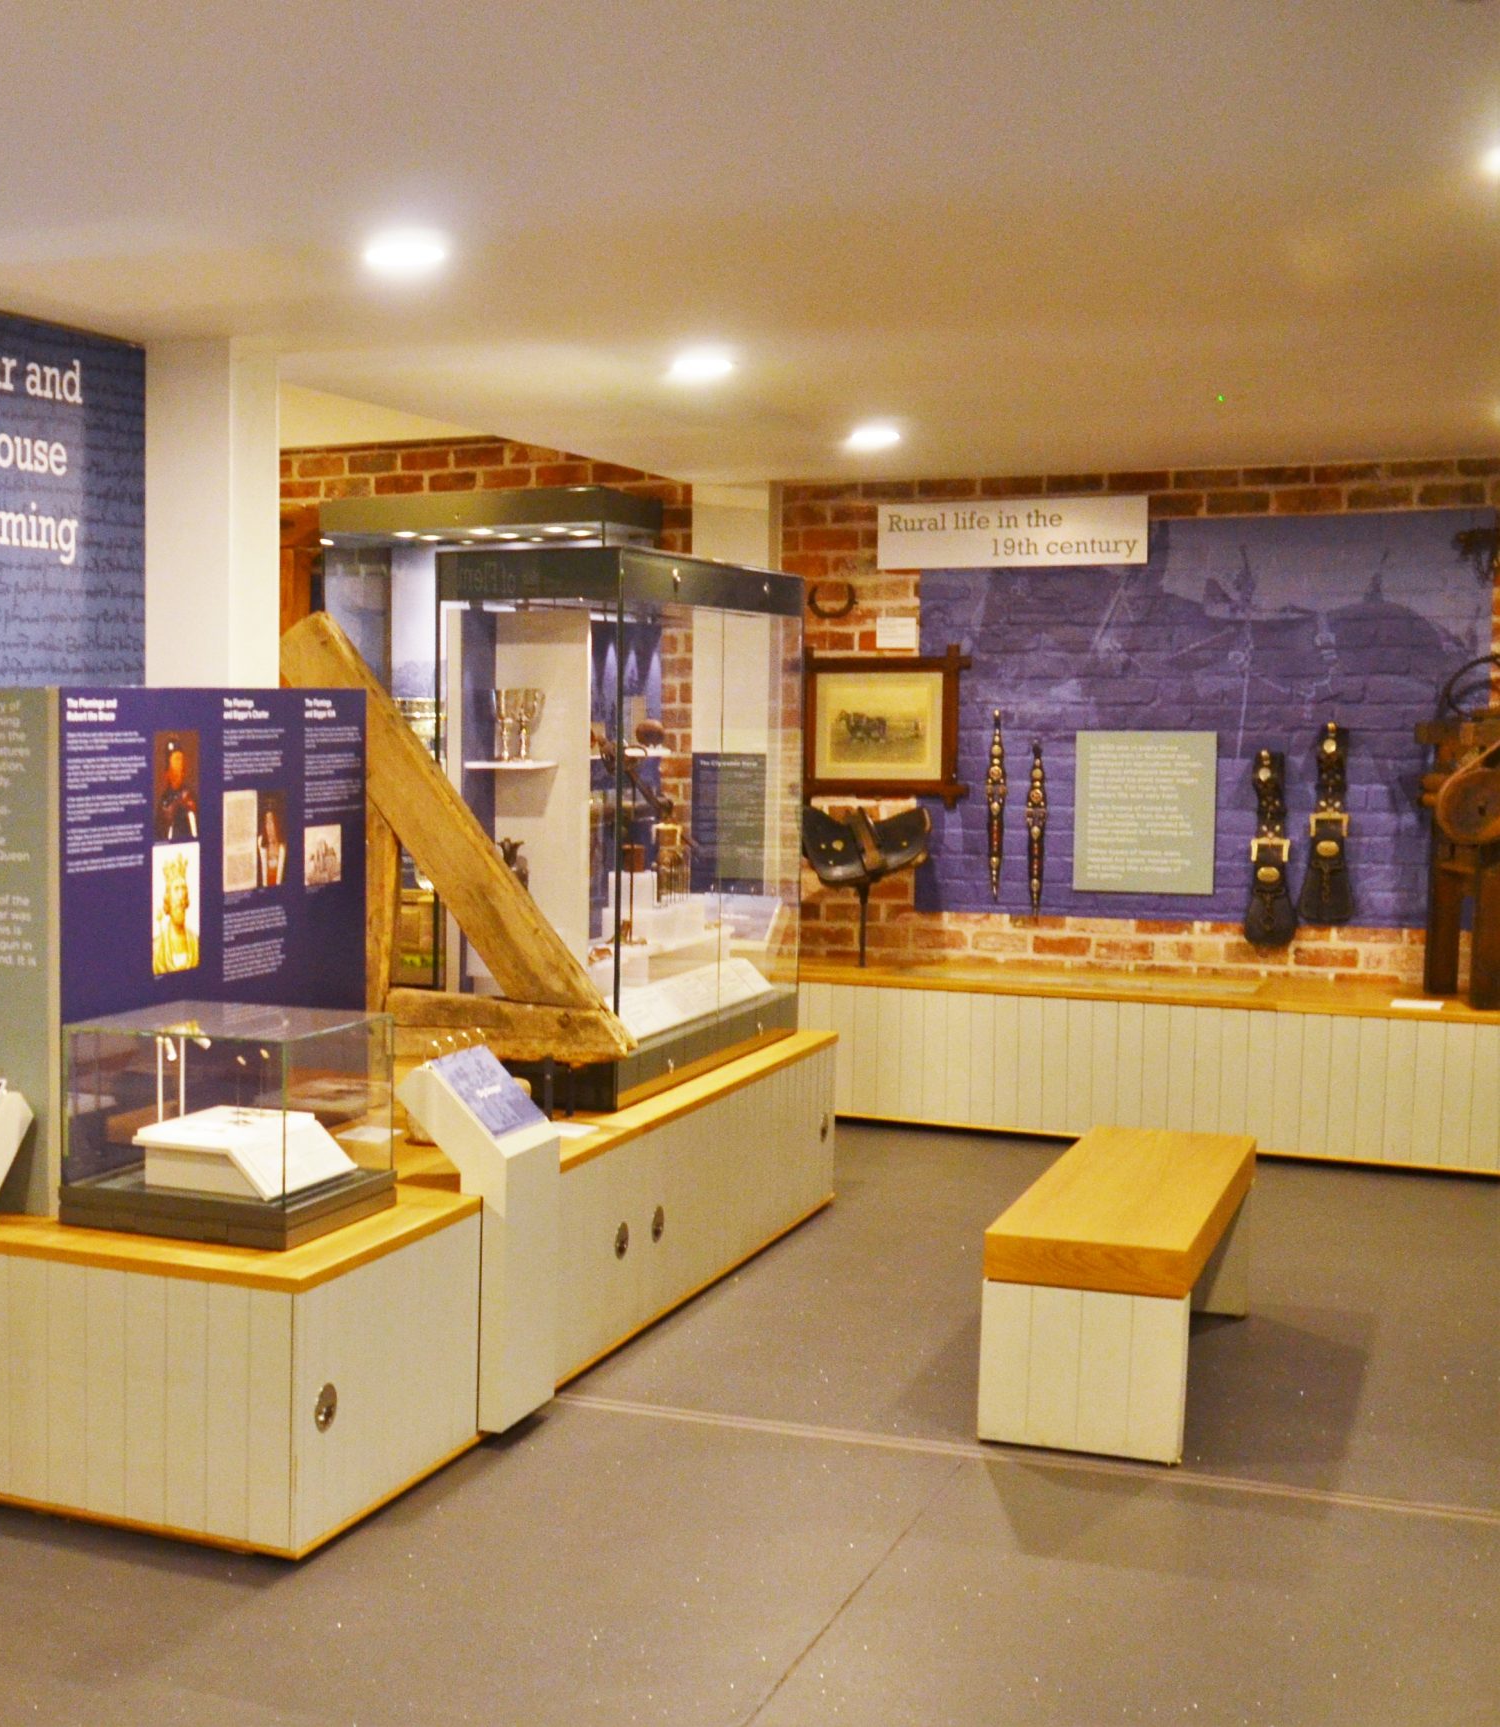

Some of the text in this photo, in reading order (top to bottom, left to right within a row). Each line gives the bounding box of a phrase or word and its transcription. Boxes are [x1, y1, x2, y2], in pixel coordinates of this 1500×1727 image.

[26, 356, 83, 404] and
[888, 509, 1063, 532] Rural life in the
[992, 537, 1138, 558] 19th century
[67, 698, 78, 708] The
[105, 698, 117, 708] and
[88, 712, 97, 721] the
[98, 711, 115, 721] Bruce
